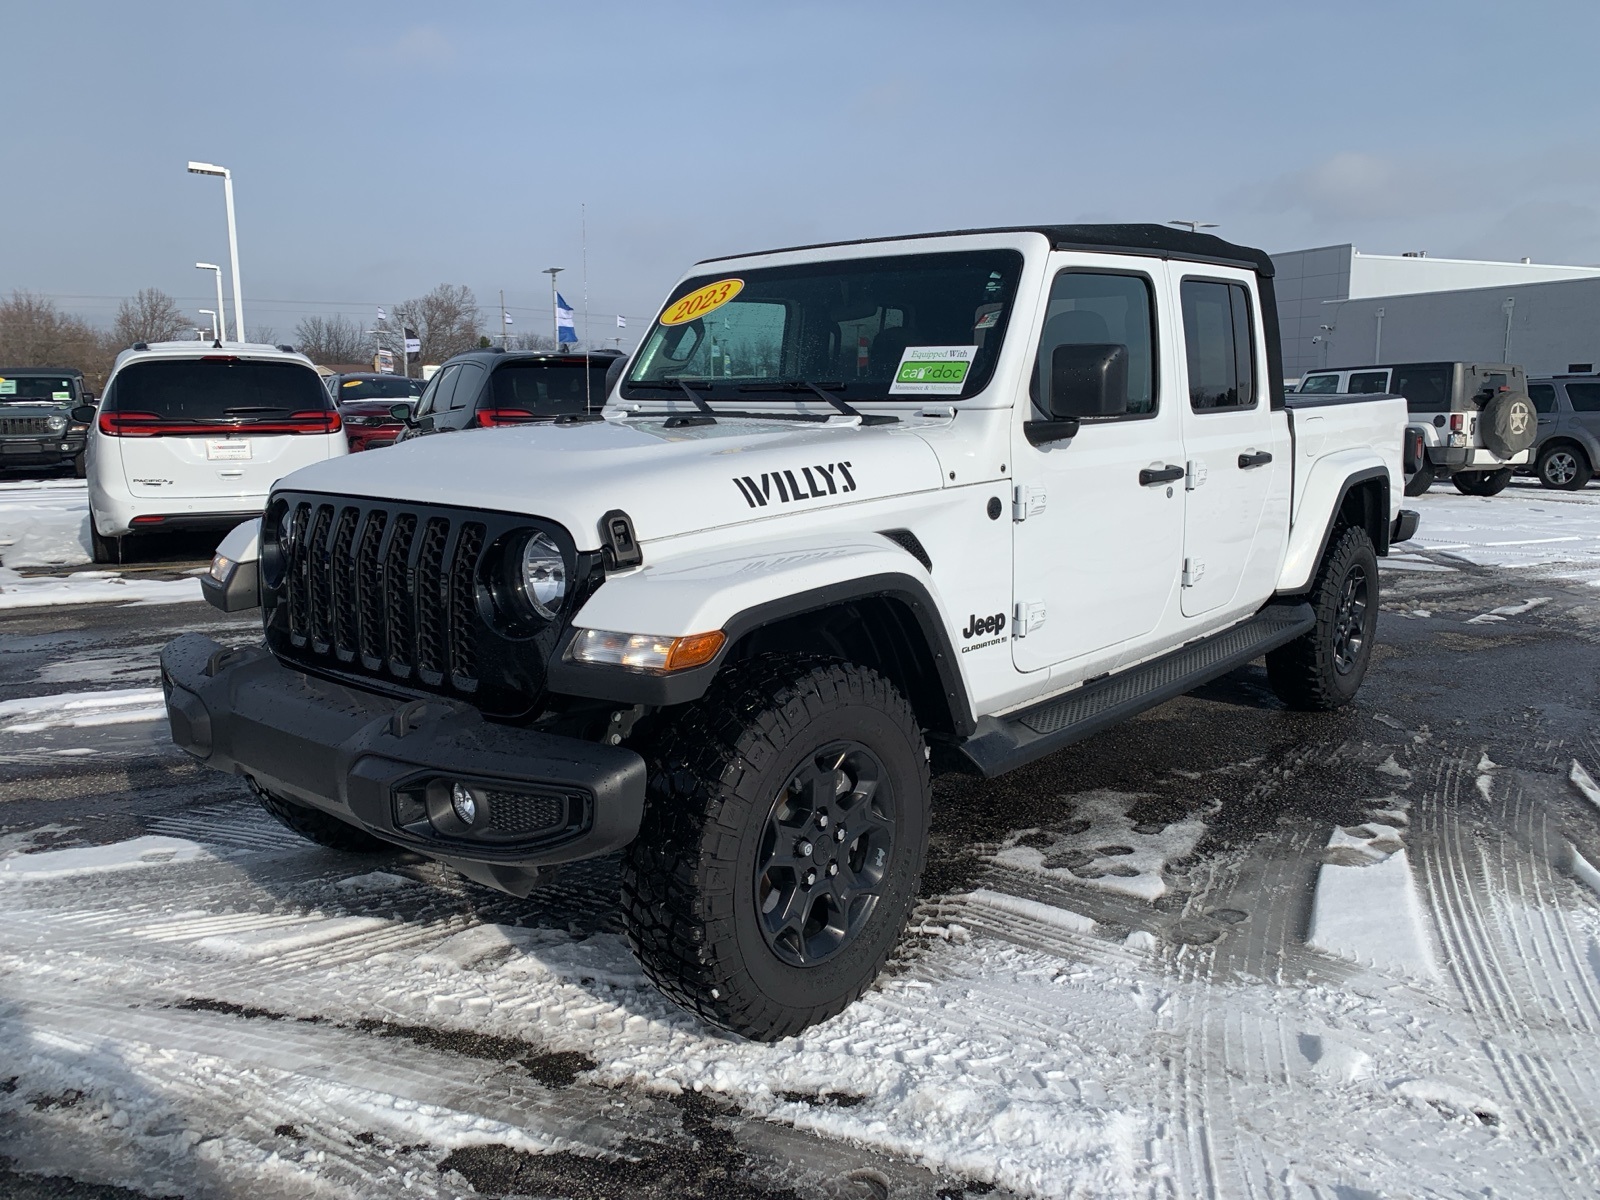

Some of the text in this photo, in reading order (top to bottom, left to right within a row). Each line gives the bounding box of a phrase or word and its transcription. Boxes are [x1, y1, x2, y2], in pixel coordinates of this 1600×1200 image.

[672, 283, 732, 322] 2023
[911, 350, 968, 359] Equipped With
[732, 461, 857, 509] WILLYS
[963, 612, 1006, 639] Jeep
[961, 638, 1001, 654] GLADIATOR
